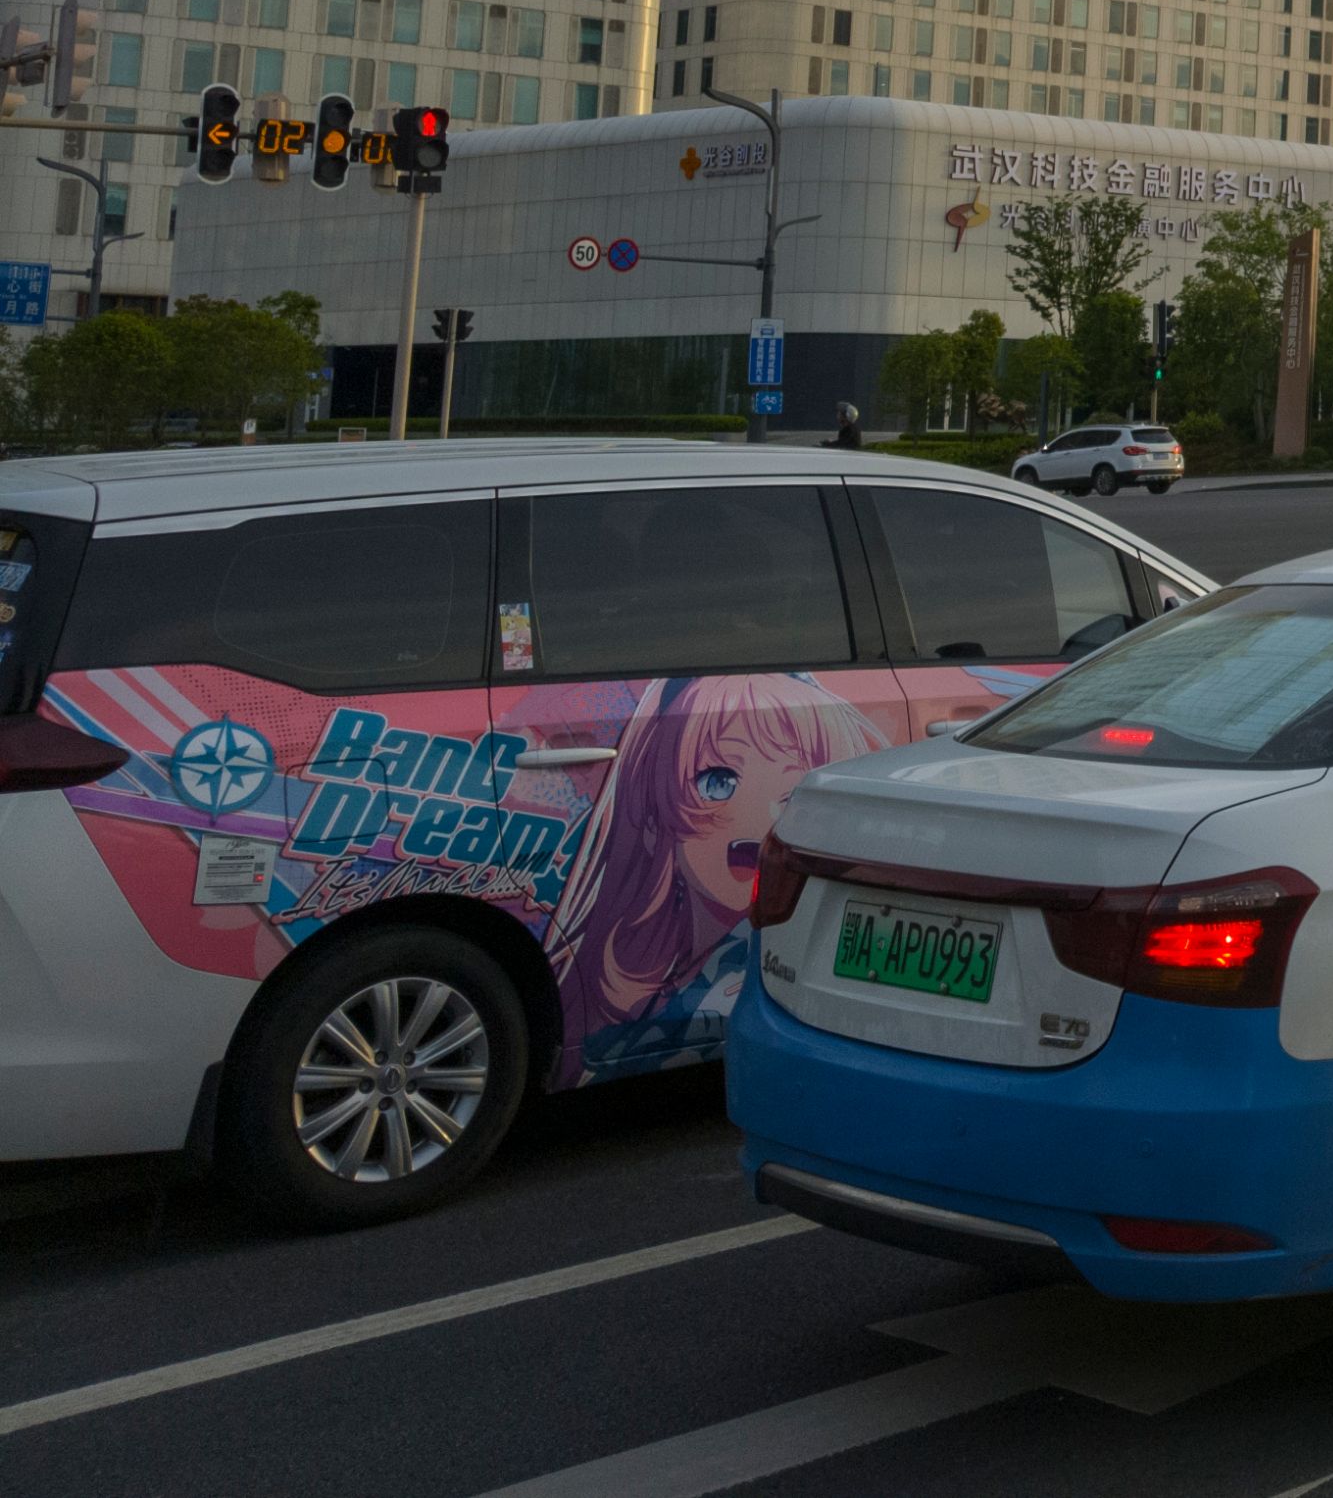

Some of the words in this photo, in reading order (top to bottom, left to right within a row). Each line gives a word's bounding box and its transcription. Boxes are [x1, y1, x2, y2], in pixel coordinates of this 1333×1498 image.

[258, 119, 306, 154] 02
[364, 133, 393, 164] 0
[703, 142, 766, 168] 光谷创投
[951, 143, 1305, 208] 武汉科技金融服务中心
[576, 245, 595, 262] 50
